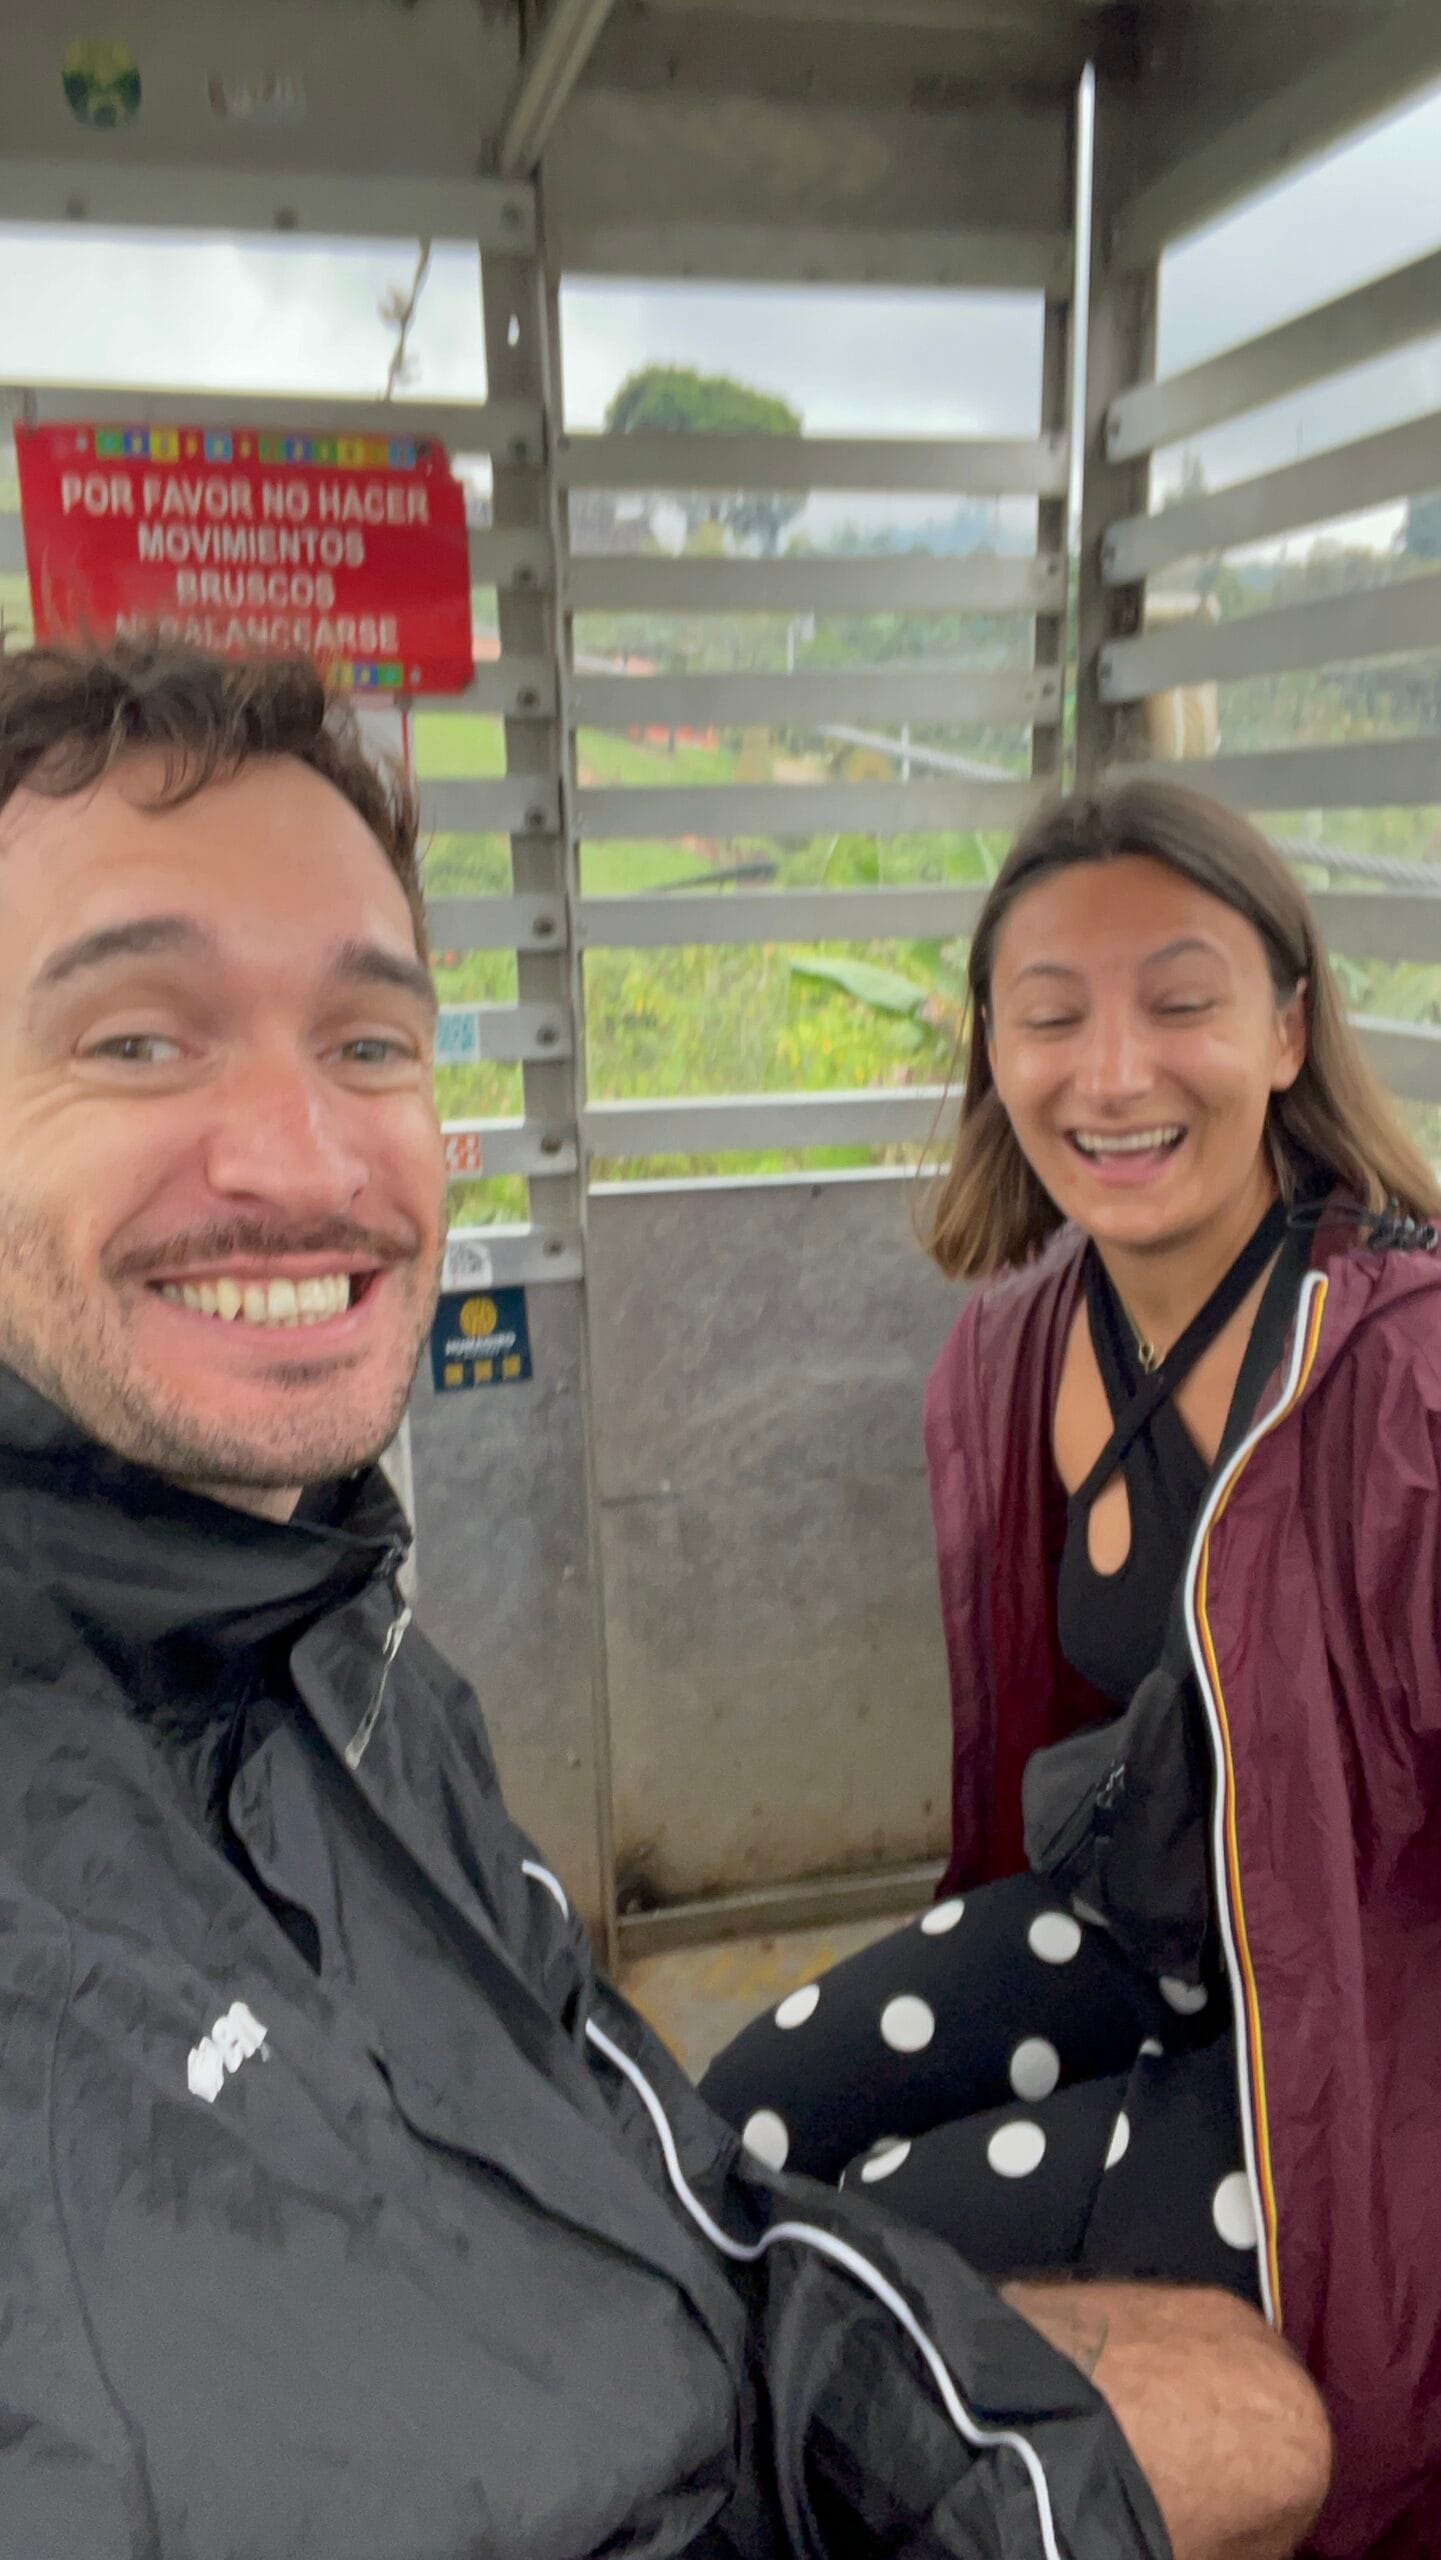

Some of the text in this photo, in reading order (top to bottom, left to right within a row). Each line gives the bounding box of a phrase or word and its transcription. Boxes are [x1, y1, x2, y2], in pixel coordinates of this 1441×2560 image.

[61, 473, 430, 526] POR FAVOR NO HACER
[137, 521, 365, 568] MOVIMIENTOS
[176, 569, 336, 610] BRUSCOS
